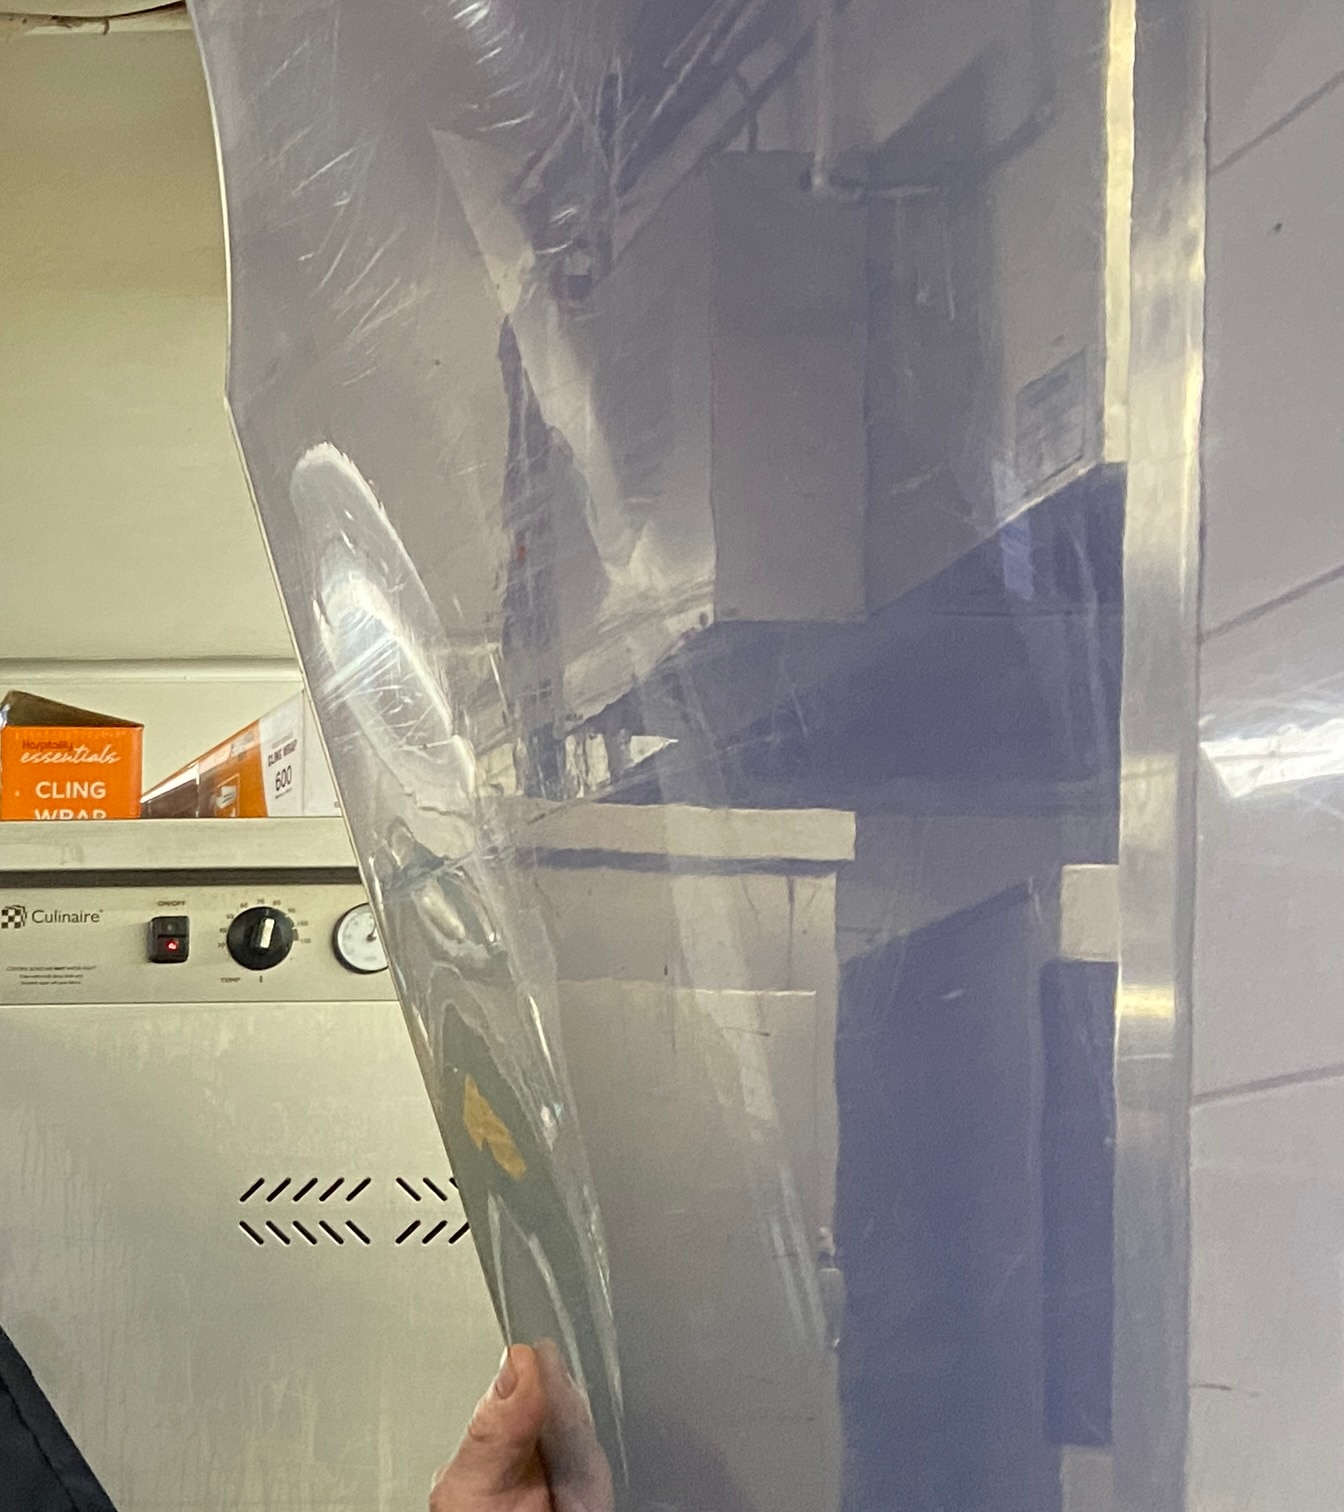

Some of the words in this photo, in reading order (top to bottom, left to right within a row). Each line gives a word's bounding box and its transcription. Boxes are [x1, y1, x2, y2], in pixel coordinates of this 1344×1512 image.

[20, 744, 121, 763] essentials
[275, 765, 292, 791] 600
[35, 781, 107, 799] CLING
[32, 909, 100, 923] Culinaire
